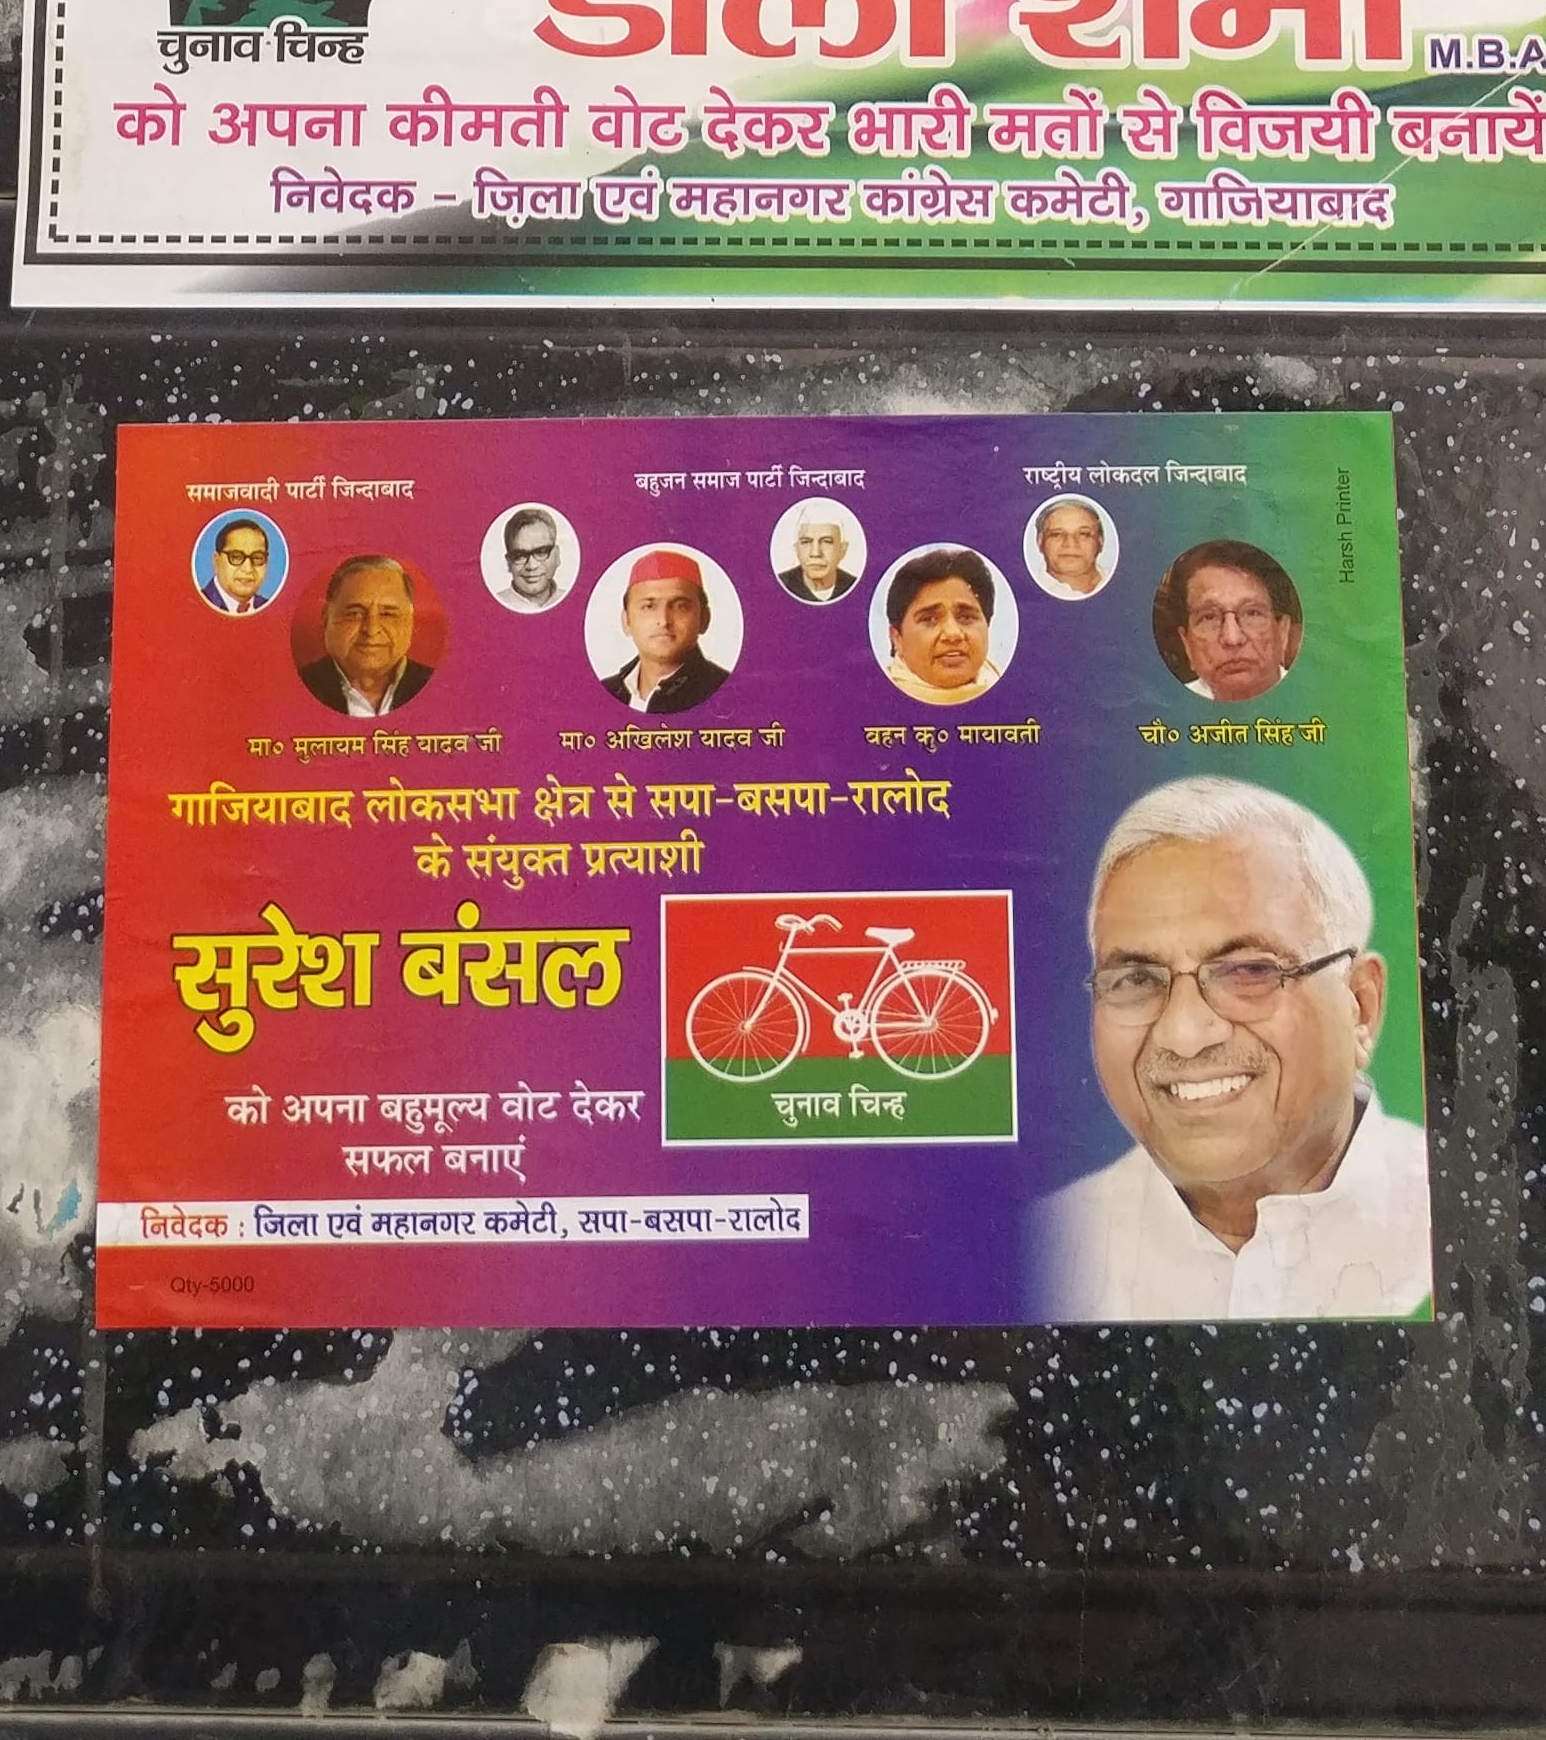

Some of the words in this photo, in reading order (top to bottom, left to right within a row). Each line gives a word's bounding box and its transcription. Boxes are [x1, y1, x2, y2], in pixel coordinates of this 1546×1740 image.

[157, 30, 266, 72] चुनाव
[268, 20, 369, 63] चिन्ह
[113, 83, 186, 146] को
[209, 103, 367, 146] अपना
[386, 85, 570, 148] कीमती
[589, 85, 686, 150] वोट
[705, 86, 831, 151] देकर
[849, 88, 971, 152] भारी
[991, 90, 1103, 152] मतों
[1124, 90, 1178, 154] से
[1197, 89, 1374, 155] विजयी
[270, 166, 417, 214] निवेदक
[592, 171, 659, 217] एवं
[671, 178, 849, 221] महानगर
[865, 173, 992, 219] कांग्रेस
[1007, 170, 1145, 229] कमेटी,
[1159, 175, 1394, 224] गाजियाबाद
[186, 479, 279, 503] समाजवादी
[286, 477, 326, 501] पार्टी
[331, 477, 414, 501] जिन्दाबाद
[635, 471, 687, 496] बहुजन
[692, 471, 740, 491] समाज
[745, 465, 785, 488] पार्टी
[788, 465, 866, 489] जिन्दाबाद
[1023, 462, 1082, 489] राष्ट्रीय
[1088, 462, 1160, 484] लोकदल
[1165, 461, 1247, 485] जिन्दाबाद
[1336, 467, 1353, 525] Printer
[1338, 530, 1355, 583] Harsh
[294, 735, 366, 763] मुलायम
[372, 730, 412, 757] सिंह
[417, 735, 469, 755] यादव
[474, 730, 502, 755] जी
[605, 726, 693, 752] अखिलेश
[700, 730, 753, 750] यादव
[757, 724, 785, 749] जी
[959, 719, 1041, 746] मायावती
[1188, 720, 1250, 745] अजीत
[1254, 720, 1293, 745] सिंह
[1299, 720, 1327, 744] जी
[168, 780, 353, 827] गाजियाबाद
[364, 777, 519, 823] लोकसभा
[533, 775, 594, 820] क्षेत्र
[607, 773, 639, 818] से
[648, 768, 952, 819] सपा-बसपा-रालोद
[413, 832, 451, 879] के
[463, 835, 572, 890] संयुक्त
[580, 830, 705, 876] प्रत्याशी
[172, 902, 380, 1055] सुरेश
[400, 901, 631, 1009] बंसल
[225, 1085, 272, 1125] को
[282, 1094, 369, 1124] अपना
[377, 1093, 490, 1133] बहुमूल्य
[499, 1082, 561, 1122] वोट
[569, 1081, 644, 1121] देकर
[772, 1090, 843, 1130] चुनाव
[848, 1084, 908, 1119] चिन्ह
[342, 1146, 430, 1176] सफल
[441, 1136, 527, 1182] बनाएं
[141, 1204, 229, 1239] निवेदक
[253, 1205, 318, 1237] जिला
[327, 1205, 363, 1237] एवं
[371, 1212, 475, 1237] महानगर
[484, 1201, 568, 1238] कमेटी,
[579, 1198, 802, 1236] सपा-बसपा-रालोद
[171, 1276, 254, 1297] Qty-5000
